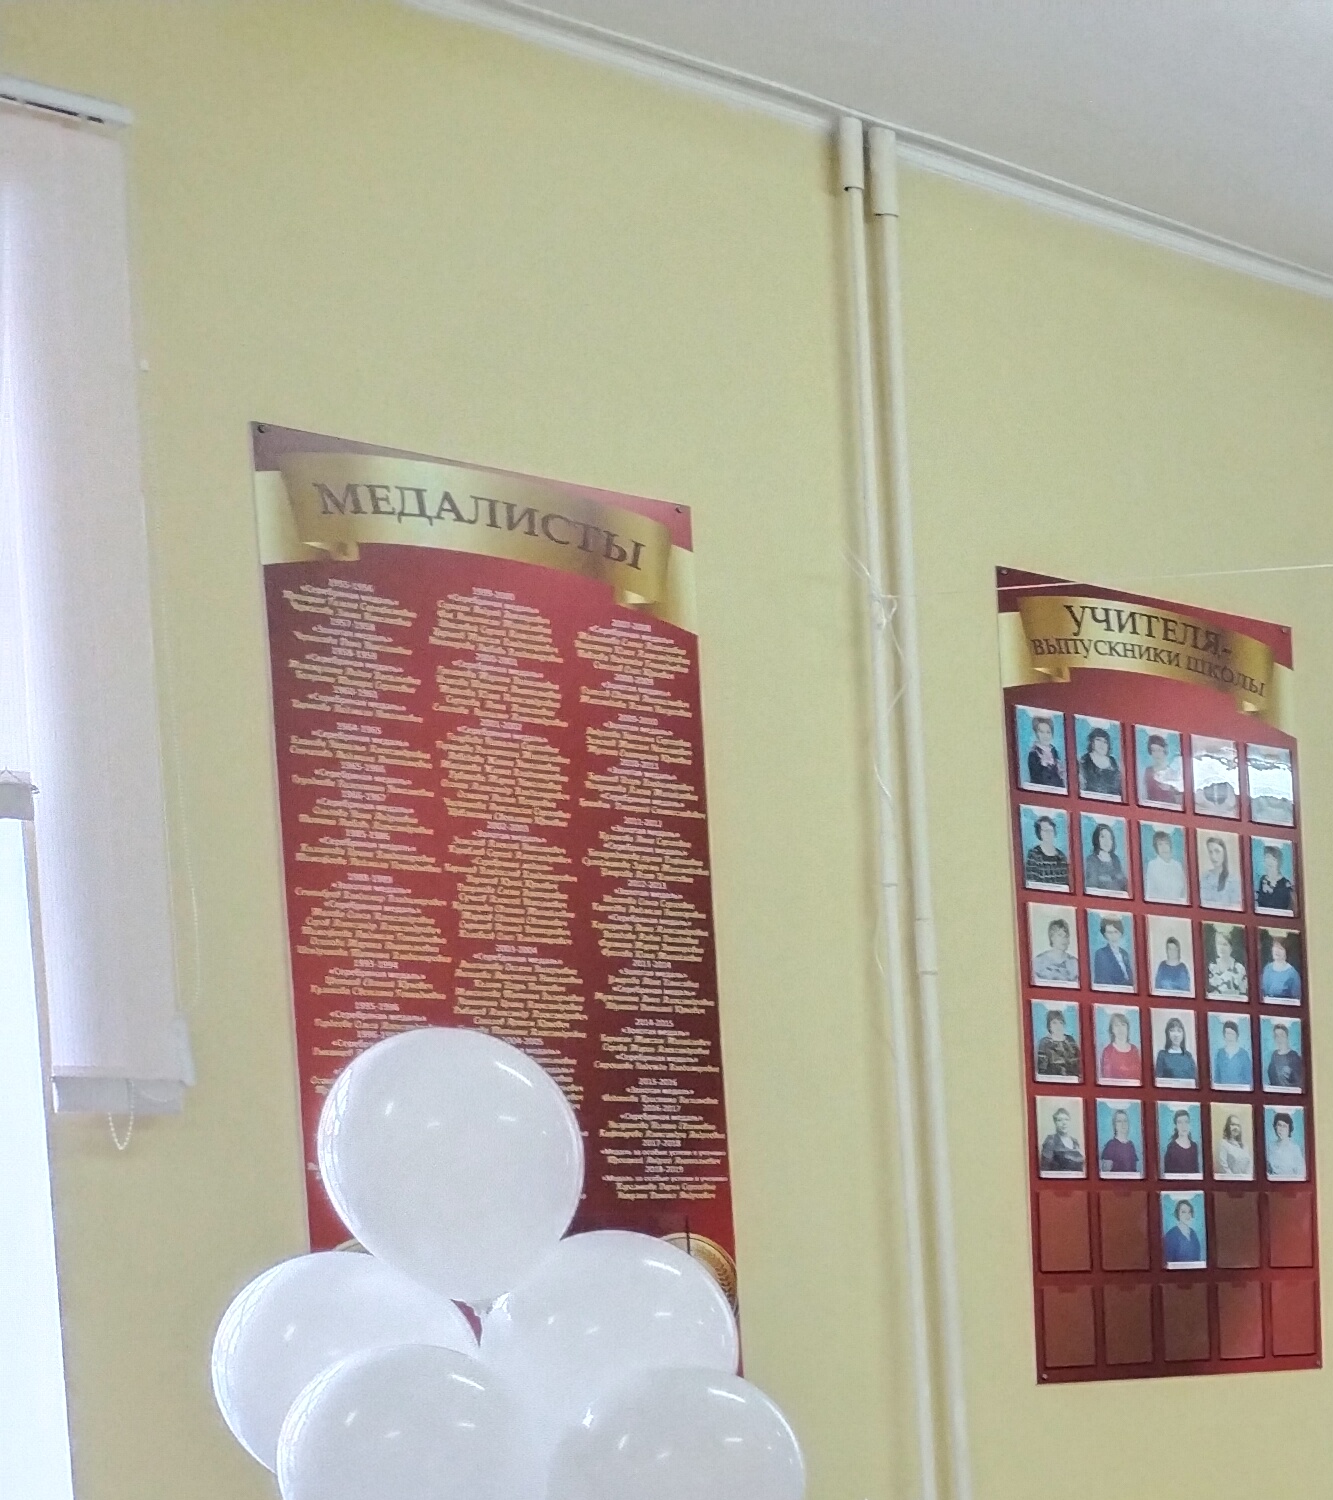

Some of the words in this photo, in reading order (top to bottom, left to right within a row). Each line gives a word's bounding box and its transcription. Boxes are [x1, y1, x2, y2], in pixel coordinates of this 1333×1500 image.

[311, 481, 647, 571] МЕДАЛИСТЫ
[1030, 637, 1181, 668] ВЫПУСКНИКИ
[1187, 655, 1267, 698] ШКОЛЫ
